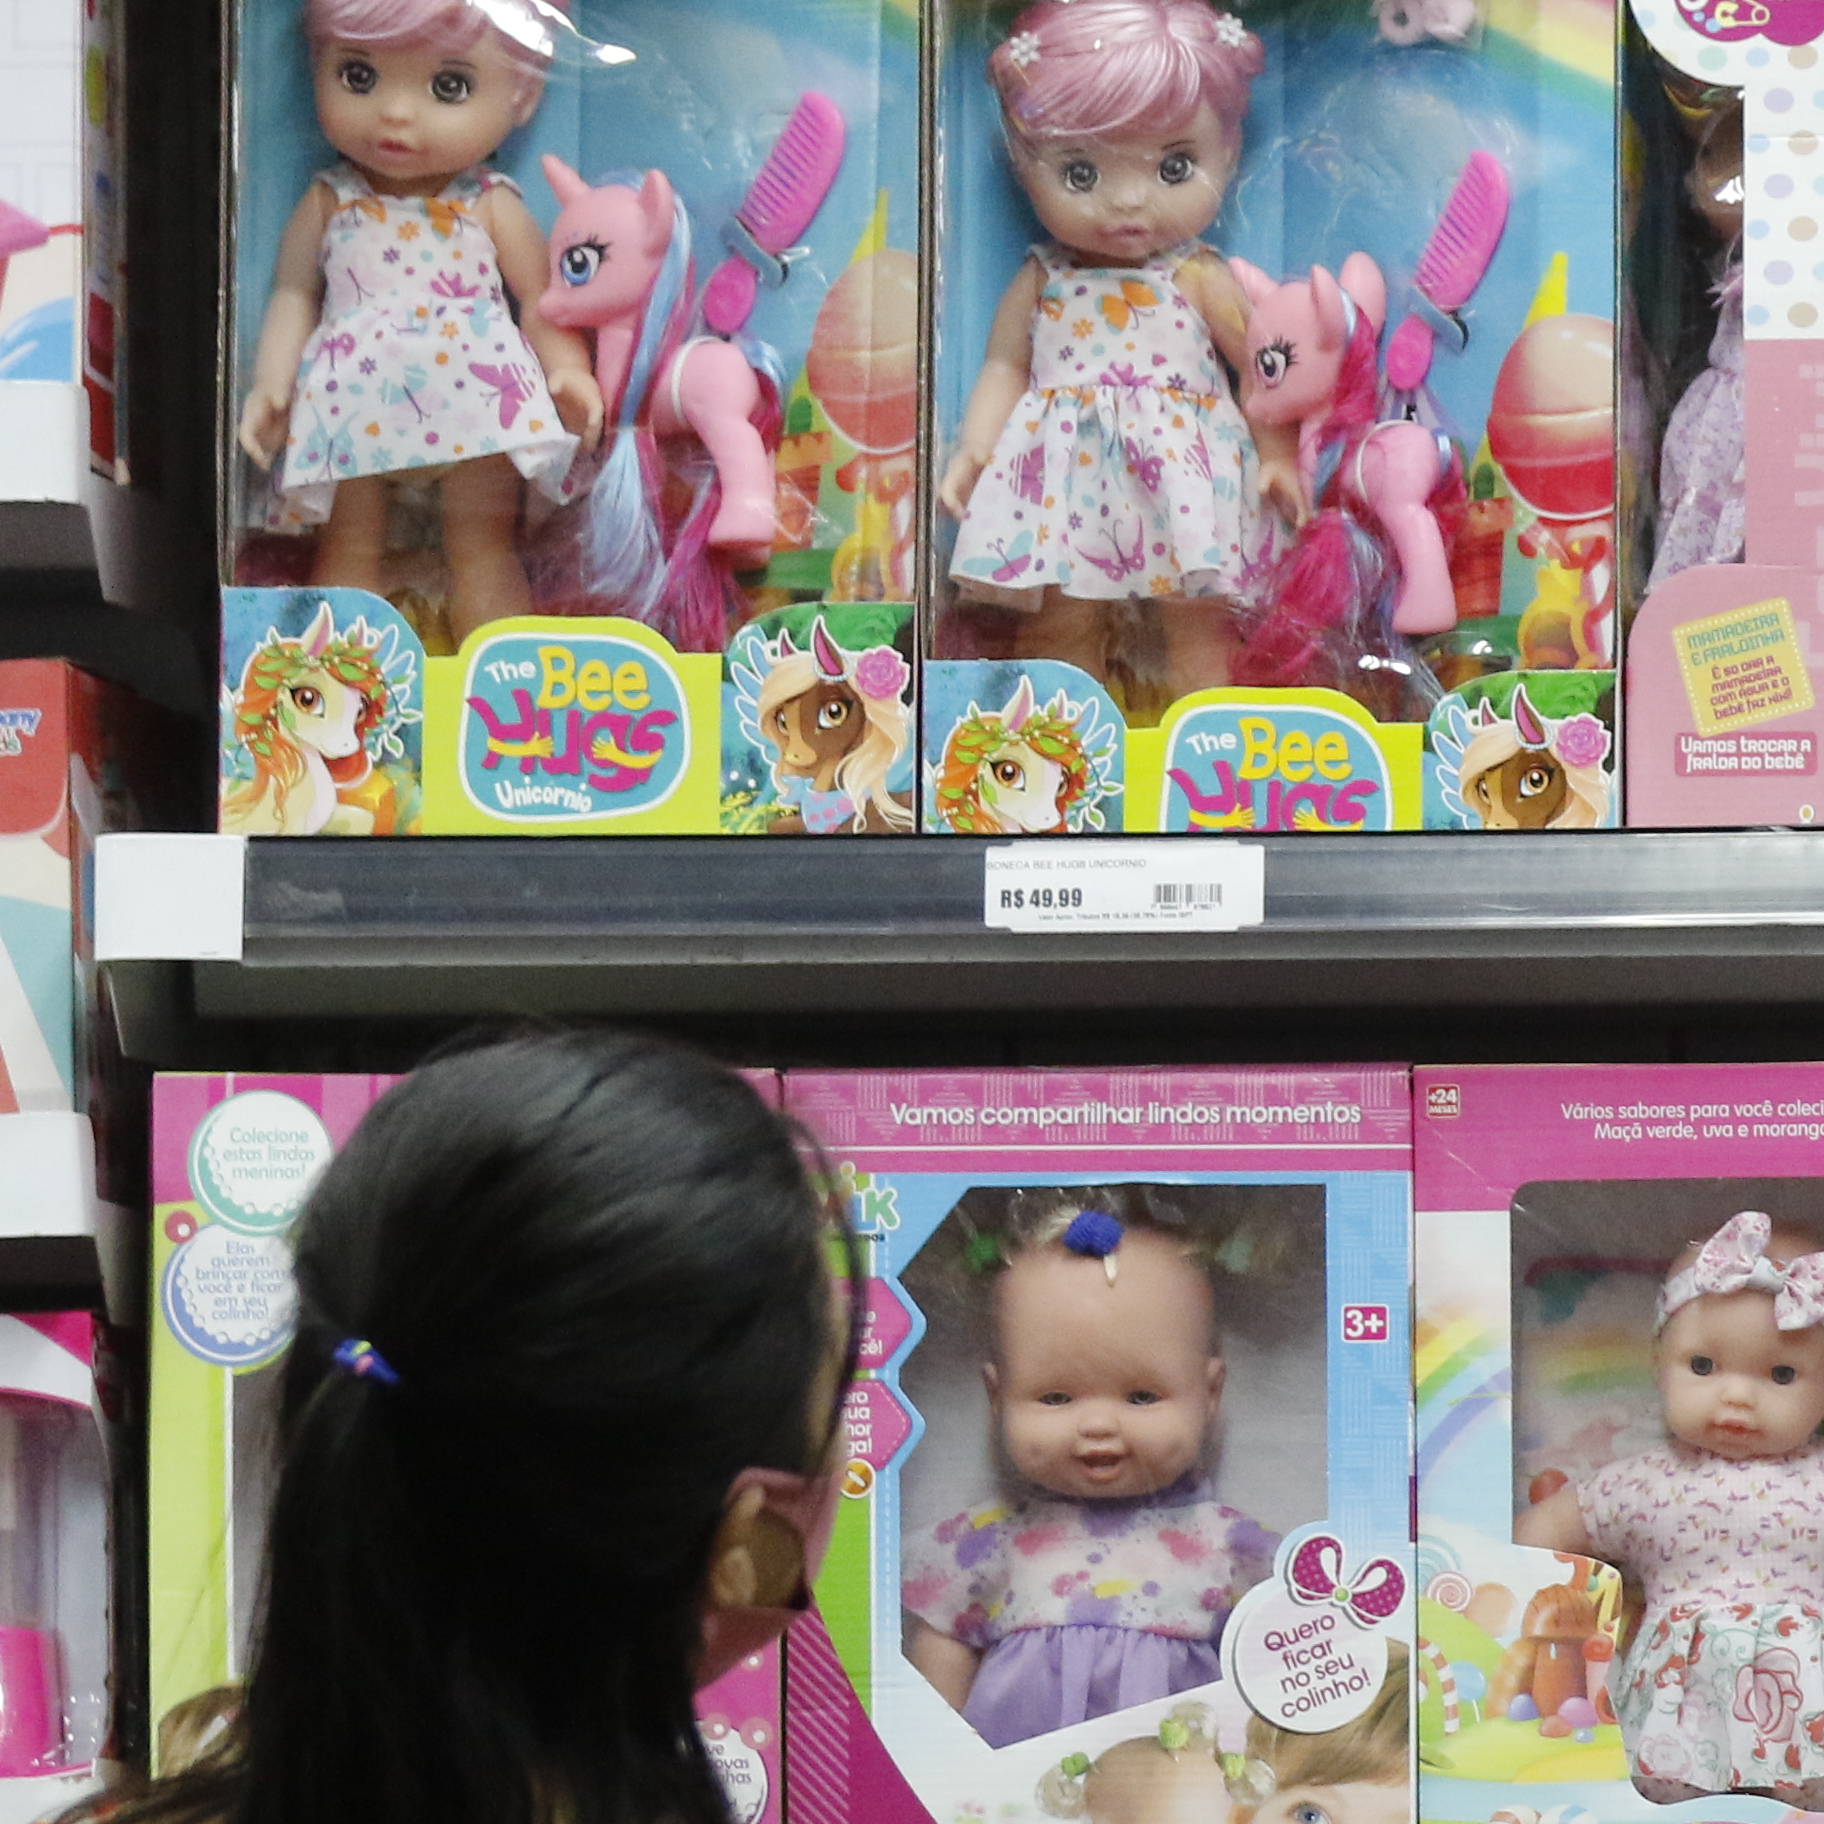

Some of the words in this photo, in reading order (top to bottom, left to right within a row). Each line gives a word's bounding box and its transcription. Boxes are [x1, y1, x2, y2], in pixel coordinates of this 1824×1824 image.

[485, 657, 536, 684] The
[538, 646, 649, 711] Bee
[1185, 729, 1237, 756] The
[1239, 719, 1351, 781] Bee
[494, 779, 592, 814] Unicornio
[1000, 889, 1024, 909] R$
[1030, 888, 1082, 909] 49,99
[1427, 1088, 1457, 1104] +24
[890, 1102, 976, 1126] Vamos
[980, 1102, 1144, 1128] compartilhar
[1148, 1102, 1215, 1125] lindos
[1219, 1102, 1361, 1124] momentos
[1562, 1103, 1613, 1121] Vários
[1618, 1102, 1685, 1119] sabores
[1690, 1105, 1730, 1121] para
[1734, 1100, 1773, 1117] você
[230, 1128, 309, 1143] Colecione
[1594, 1122, 1642, 1142] Maçã
[1645, 1121, 1698, 1141] verde,
[1703, 1125, 1733, 1138] uva
[1738, 1125, 1748, 1138] e
[267, 1146, 316, 1161] lindas
[233, 1164, 305, 1179] meninas!
[1345, 1309, 1383, 1337] 3+
[1264, 1615, 1335, 1651] Quero
[1282, 1639, 1333, 1671] ficar
[1280, 1671, 1311, 1694] no
[1314, 1653, 1355, 1680] seu
[1281, 1667, 1371, 1718] colinho!
